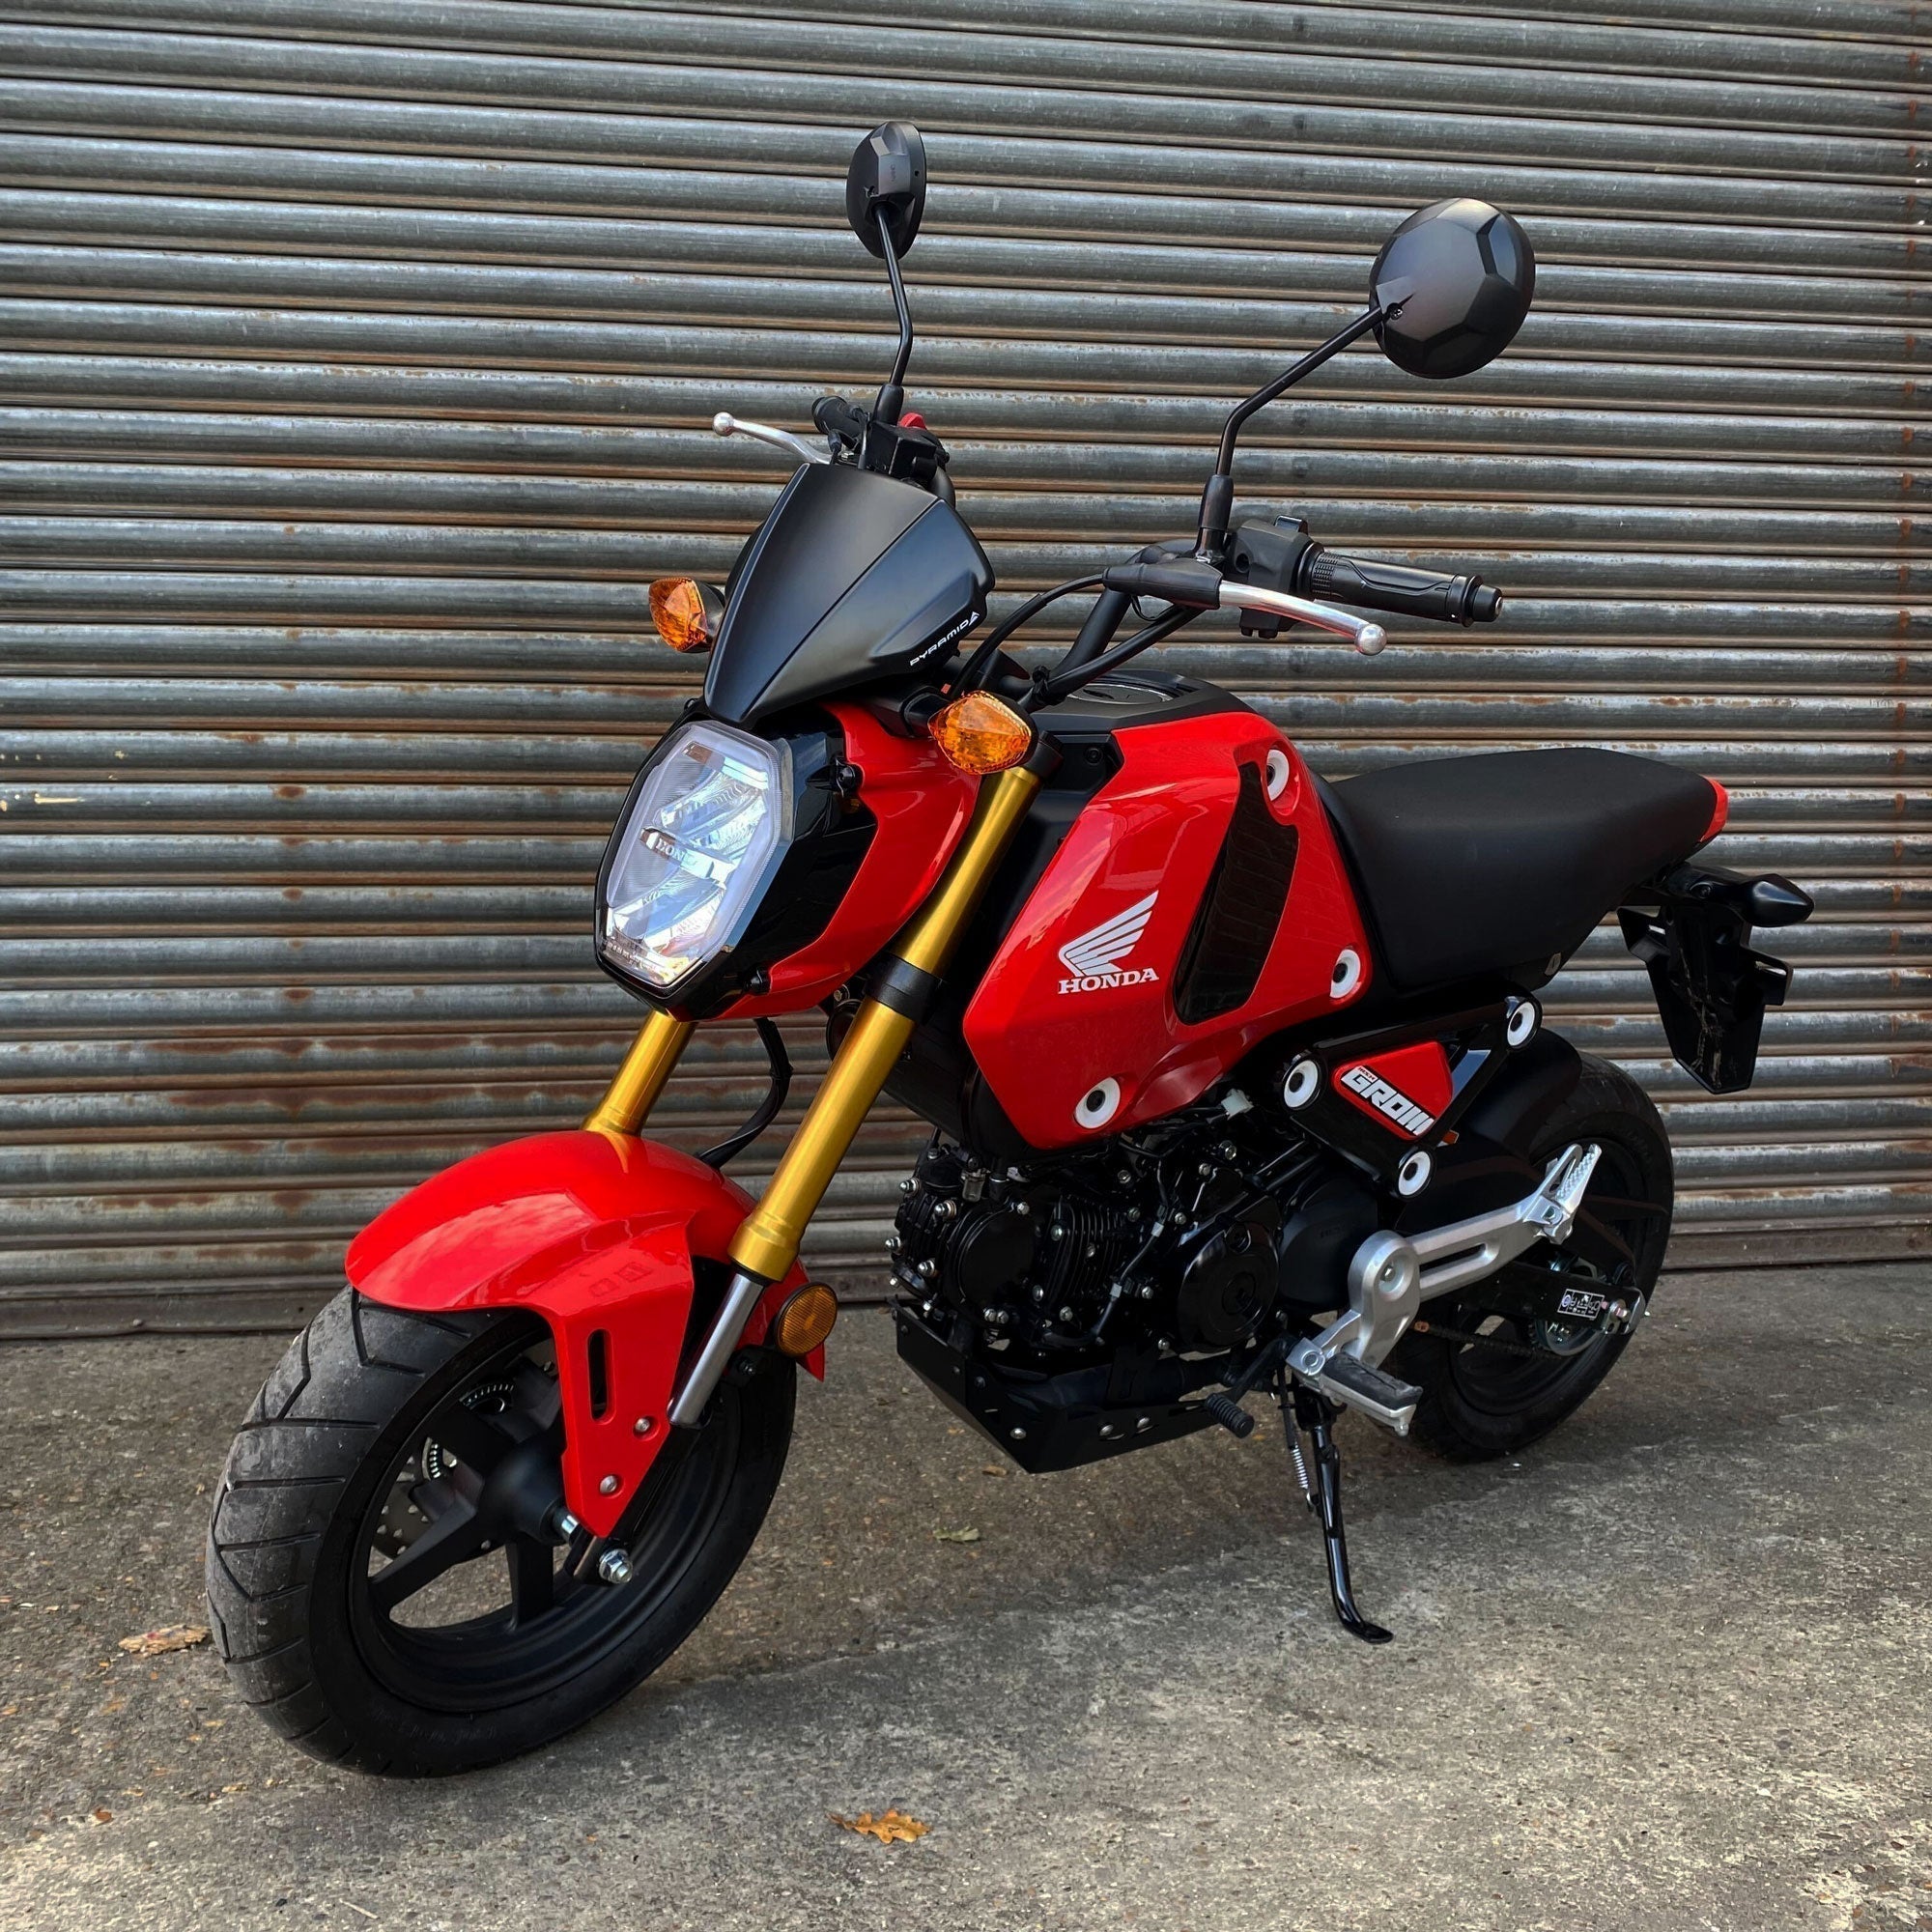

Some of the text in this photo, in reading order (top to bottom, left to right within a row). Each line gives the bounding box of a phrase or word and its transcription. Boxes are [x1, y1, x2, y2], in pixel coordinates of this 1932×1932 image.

[909, 618, 969, 667] PYRAMID
[1058, 967, 1159, 994] HONDA
[1340, 1066, 1435, 1136] GROM
